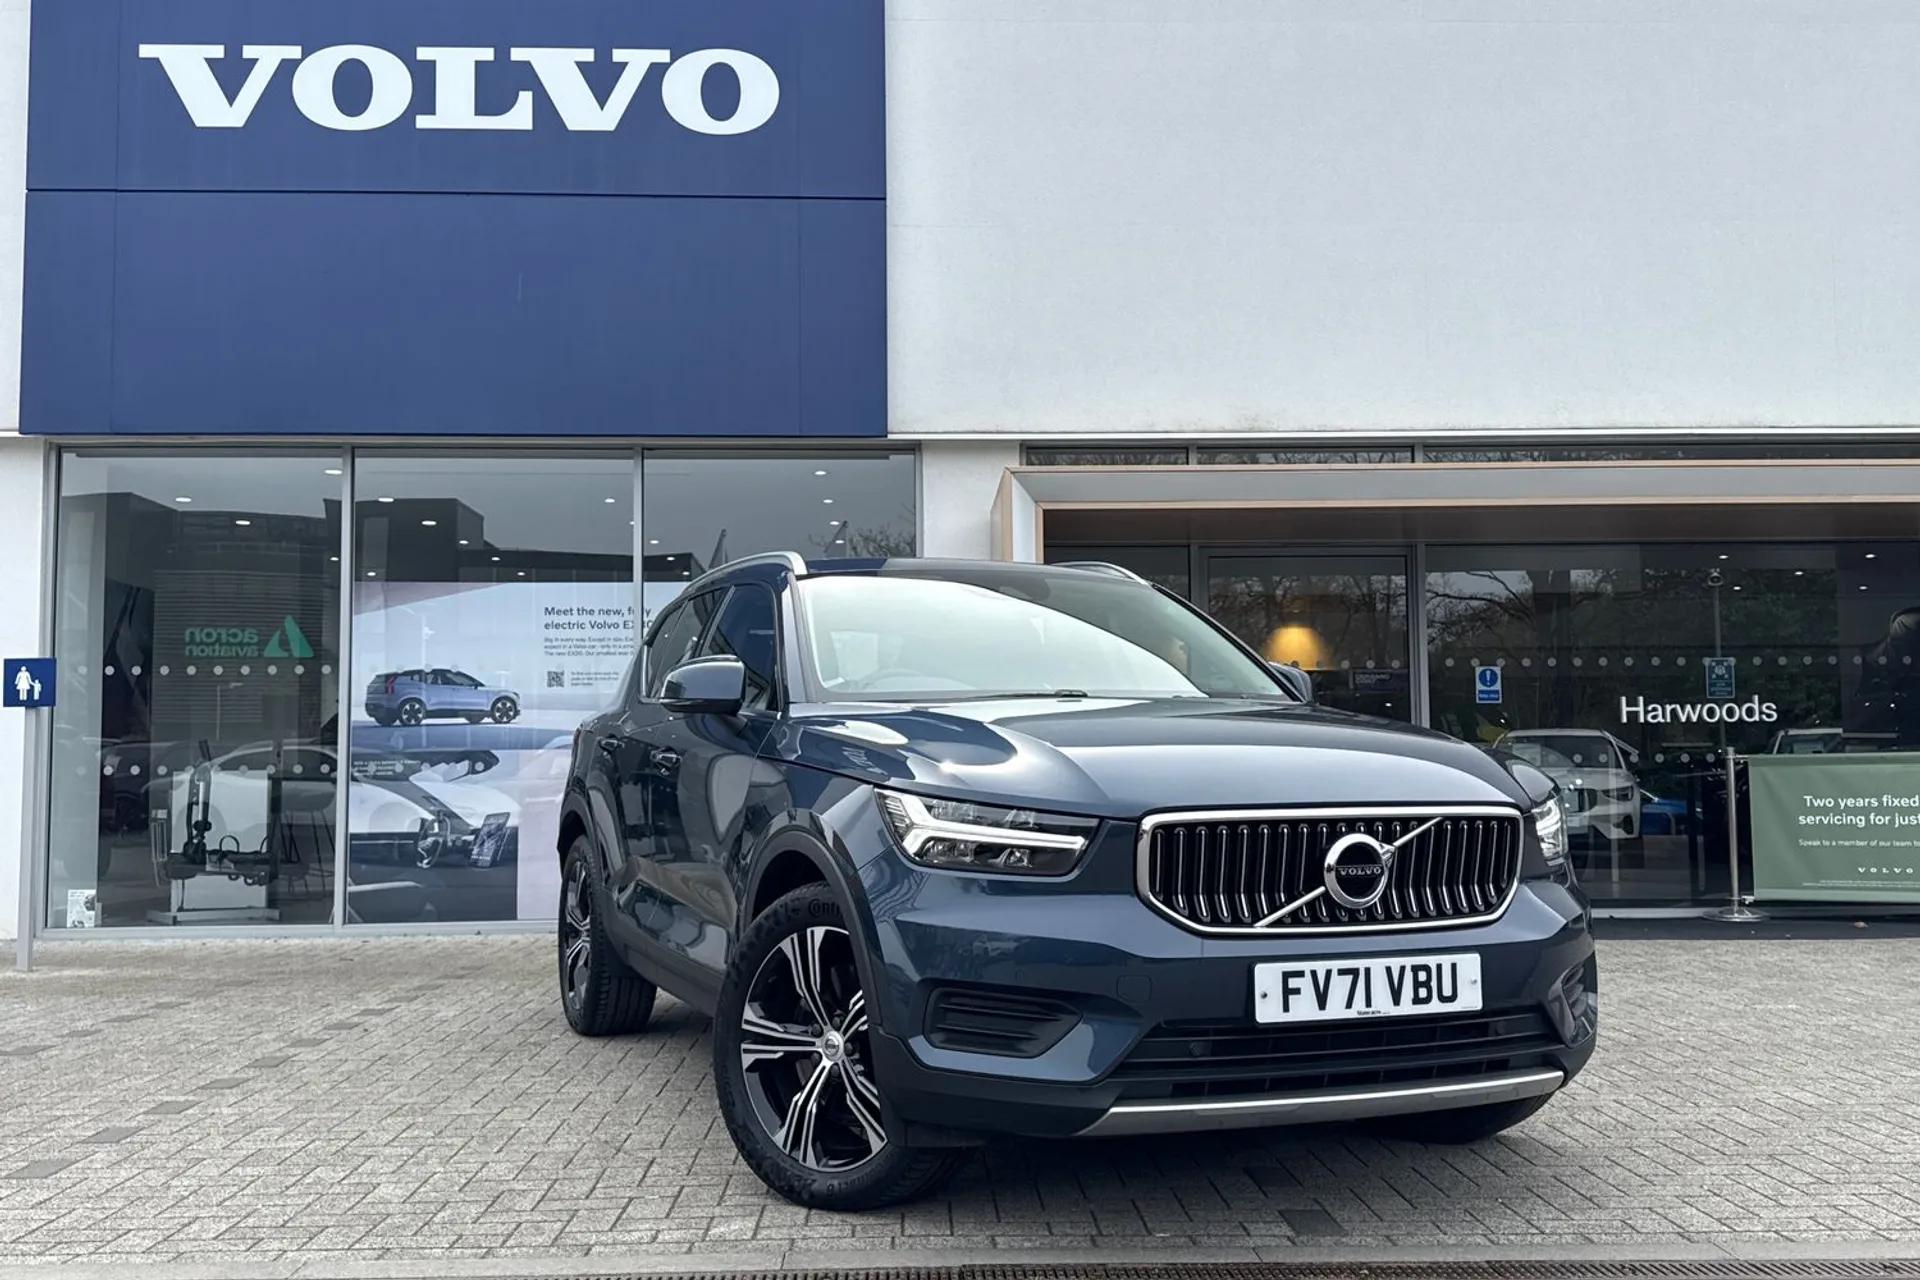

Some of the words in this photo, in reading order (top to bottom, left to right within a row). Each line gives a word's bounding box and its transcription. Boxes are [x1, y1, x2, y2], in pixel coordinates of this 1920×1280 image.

[138, 43, 780, 135] VOLVO
[544, 606, 574, 616] Meet
[576, 606, 595, 616] the
[597, 608, 625, 618] new,
[544, 619, 586, 630] electric
[588, 619, 620, 630] Volvo
[1620, 694, 1778, 723] Harwoods
[1803, 795, 1834, 807] Two
[1838, 797, 1879, 810] years
[1882, 794, 1919, 807] fixed
[1798, 812, 1865, 828] servicing
[1869, 812, 1892, 825] for
[1798, 838, 1821, 847] Speak
[1838, 839, 1868, 847] member
[1337, 866, 1381, 876] VOLVO
[1857, 866, 1914, 874] VOLVO
[1281, 966, 1373, 1013] FV71
[1385, 962, 1458, 1007] VBU
